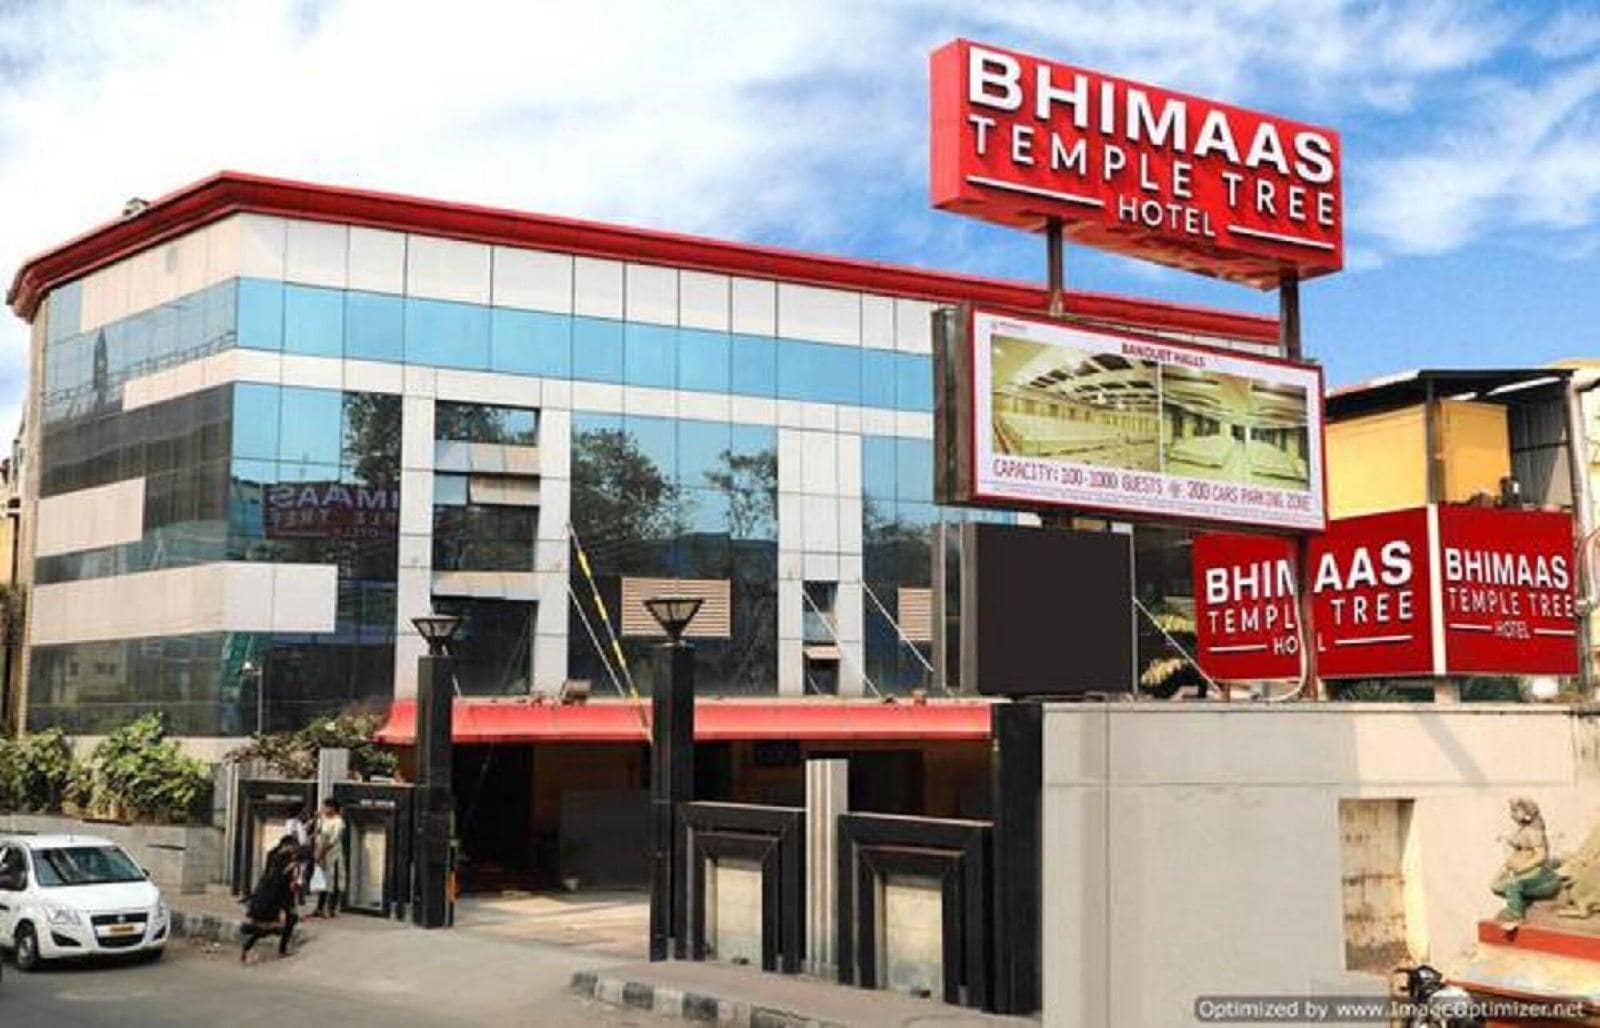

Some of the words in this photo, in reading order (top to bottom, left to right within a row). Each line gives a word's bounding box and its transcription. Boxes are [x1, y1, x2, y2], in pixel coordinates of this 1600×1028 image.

[968, 45, 1335, 185] BHIMAAS
[968, 113, 1193, 199] TEMPLE
[1221, 171, 1336, 228] TREE
[1117, 193, 1217, 238] HOTEL
[993, 458, 1059, 482] CAPACITY:
[1121, 473, 1163, 495] GUESTS
[1211, 483, 1239, 503] CARS
[1445, 547, 1570, 591] BHIMAAS
[1207, 603, 1295, 636] TEMPL
[1330, 590, 1413, 626] TREE
[1447, 586, 1521, 616] TEMPLE
[1527, 592, 1575, 618] TREE
[1273, 631, 1327, 656] HOL
[1495, 619, 1531, 640] HOTEL
